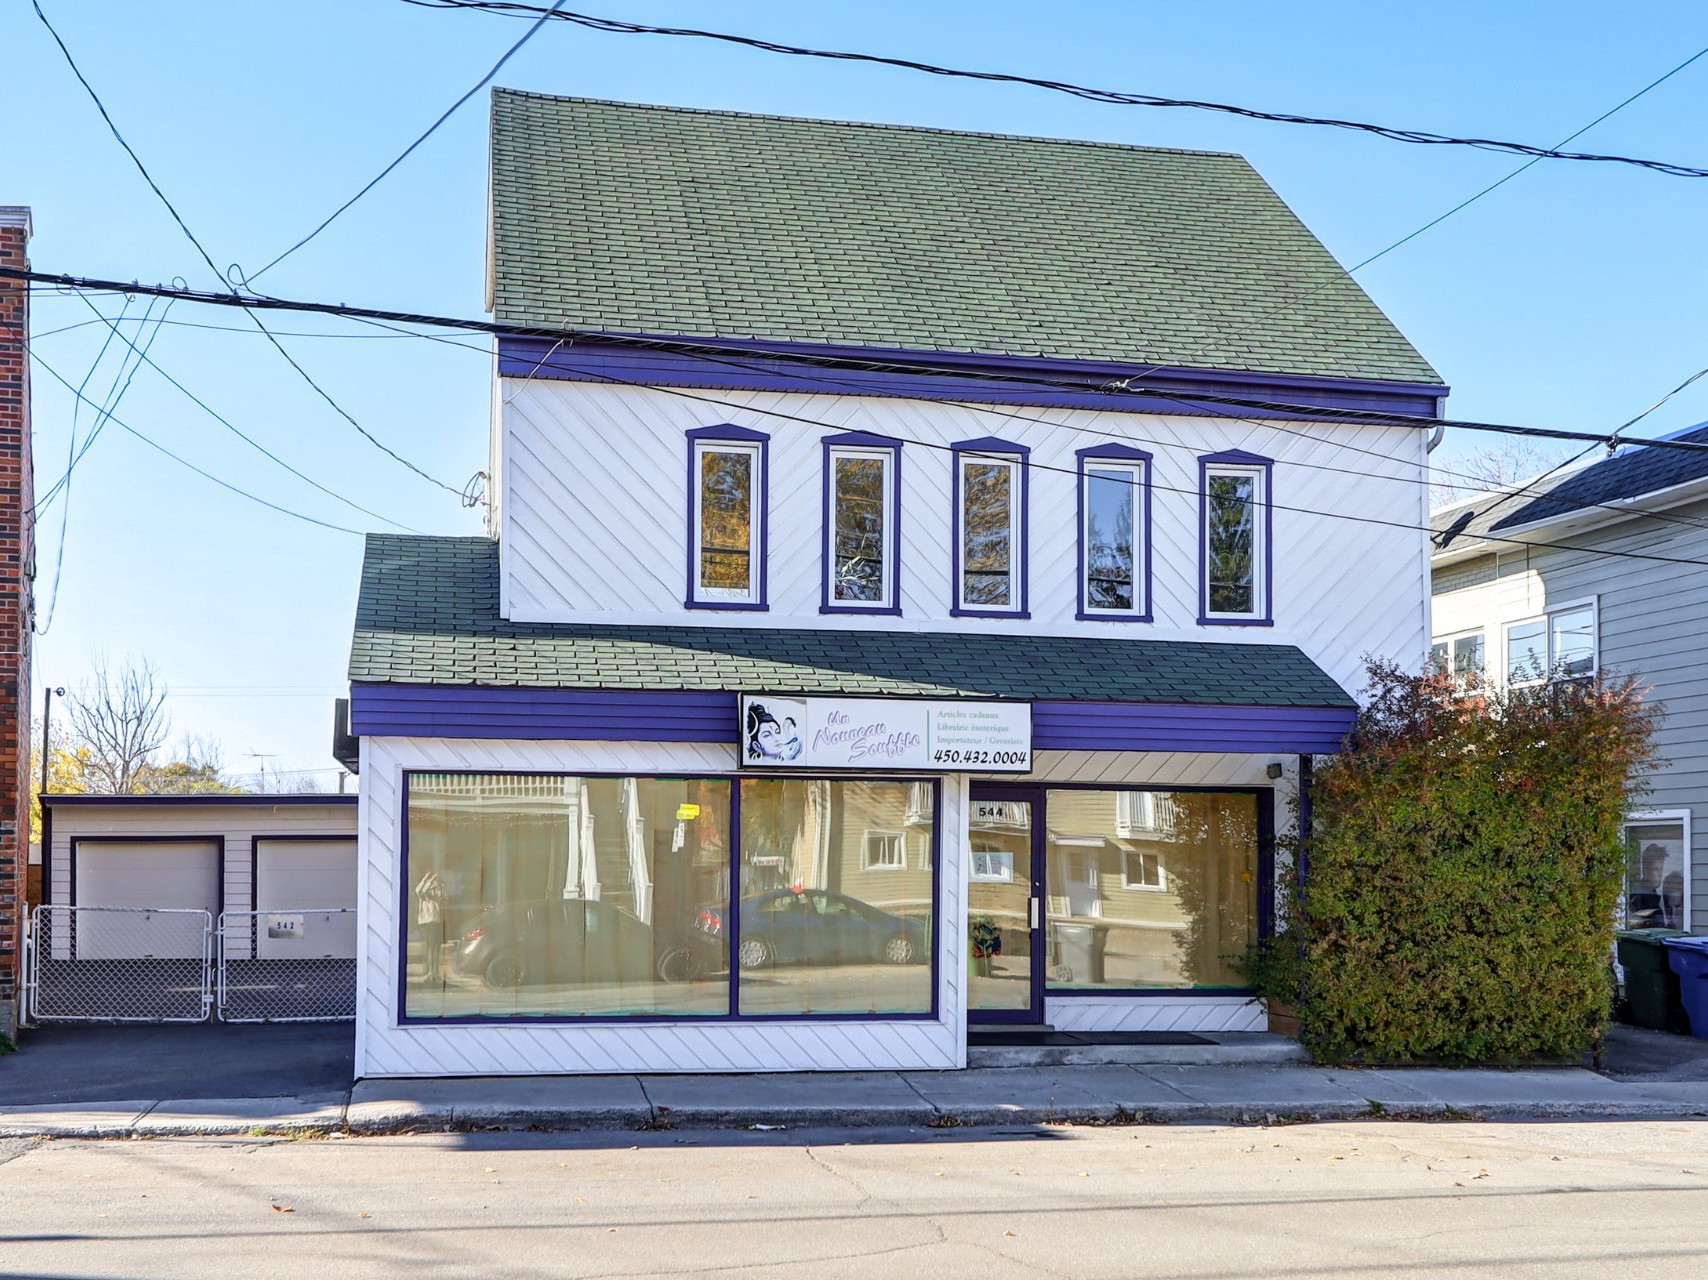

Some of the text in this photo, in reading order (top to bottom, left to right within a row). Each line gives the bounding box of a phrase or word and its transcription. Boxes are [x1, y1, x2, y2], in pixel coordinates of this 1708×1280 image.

[828, 710, 849, 726] Un
[937, 711, 999, 719] Articles cadeaux
[937, 723, 969, 731] Librairie
[812, 722, 886, 752] Nouveau
[937, 736, 982, 745] Importateur
[989, 737, 1024, 746] Grossiste
[848, 732, 920, 763] Souffle
[934, 749, 1027, 765] 450.432.0004
[979, 807, 1003, 817] 544
[277, 921, 294, 930] 542
